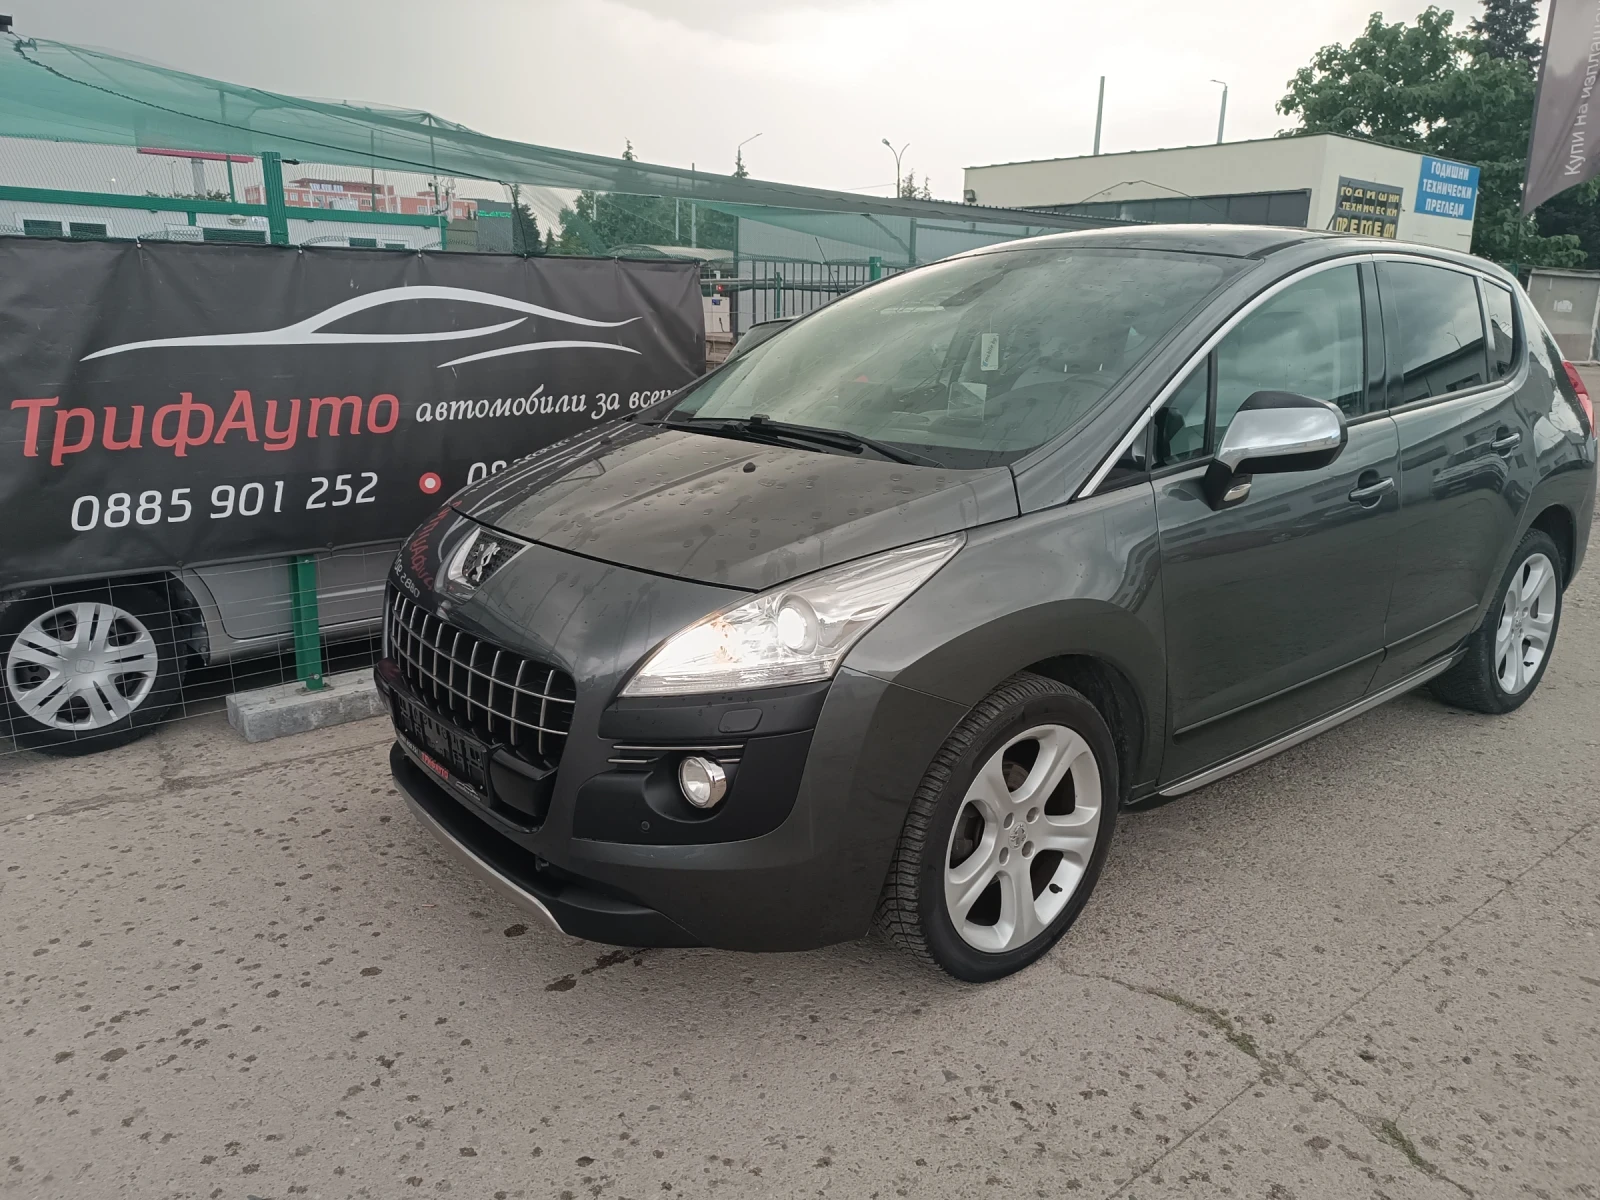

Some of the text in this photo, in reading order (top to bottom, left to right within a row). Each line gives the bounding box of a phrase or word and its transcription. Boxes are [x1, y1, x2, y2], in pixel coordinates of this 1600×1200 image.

[1574, 103, 1589, 127] на
[1565, 131, 1586, 175] Купи
[1431, 161, 1470, 180] ГОДИШНИ
[1423, 179, 1472, 199] ТЕХНИЧЕСКИ
[1425, 199, 1465, 217] ПРЕГЛЕДИ
[415, 384, 587, 422] автомобили
[591, 392, 620, 420] за
[10, 390, 400, 466] ТрифАуто
[71, 488, 192, 532] 0885
[210, 480, 284, 519] 901
[306, 472, 379, 510] 252
